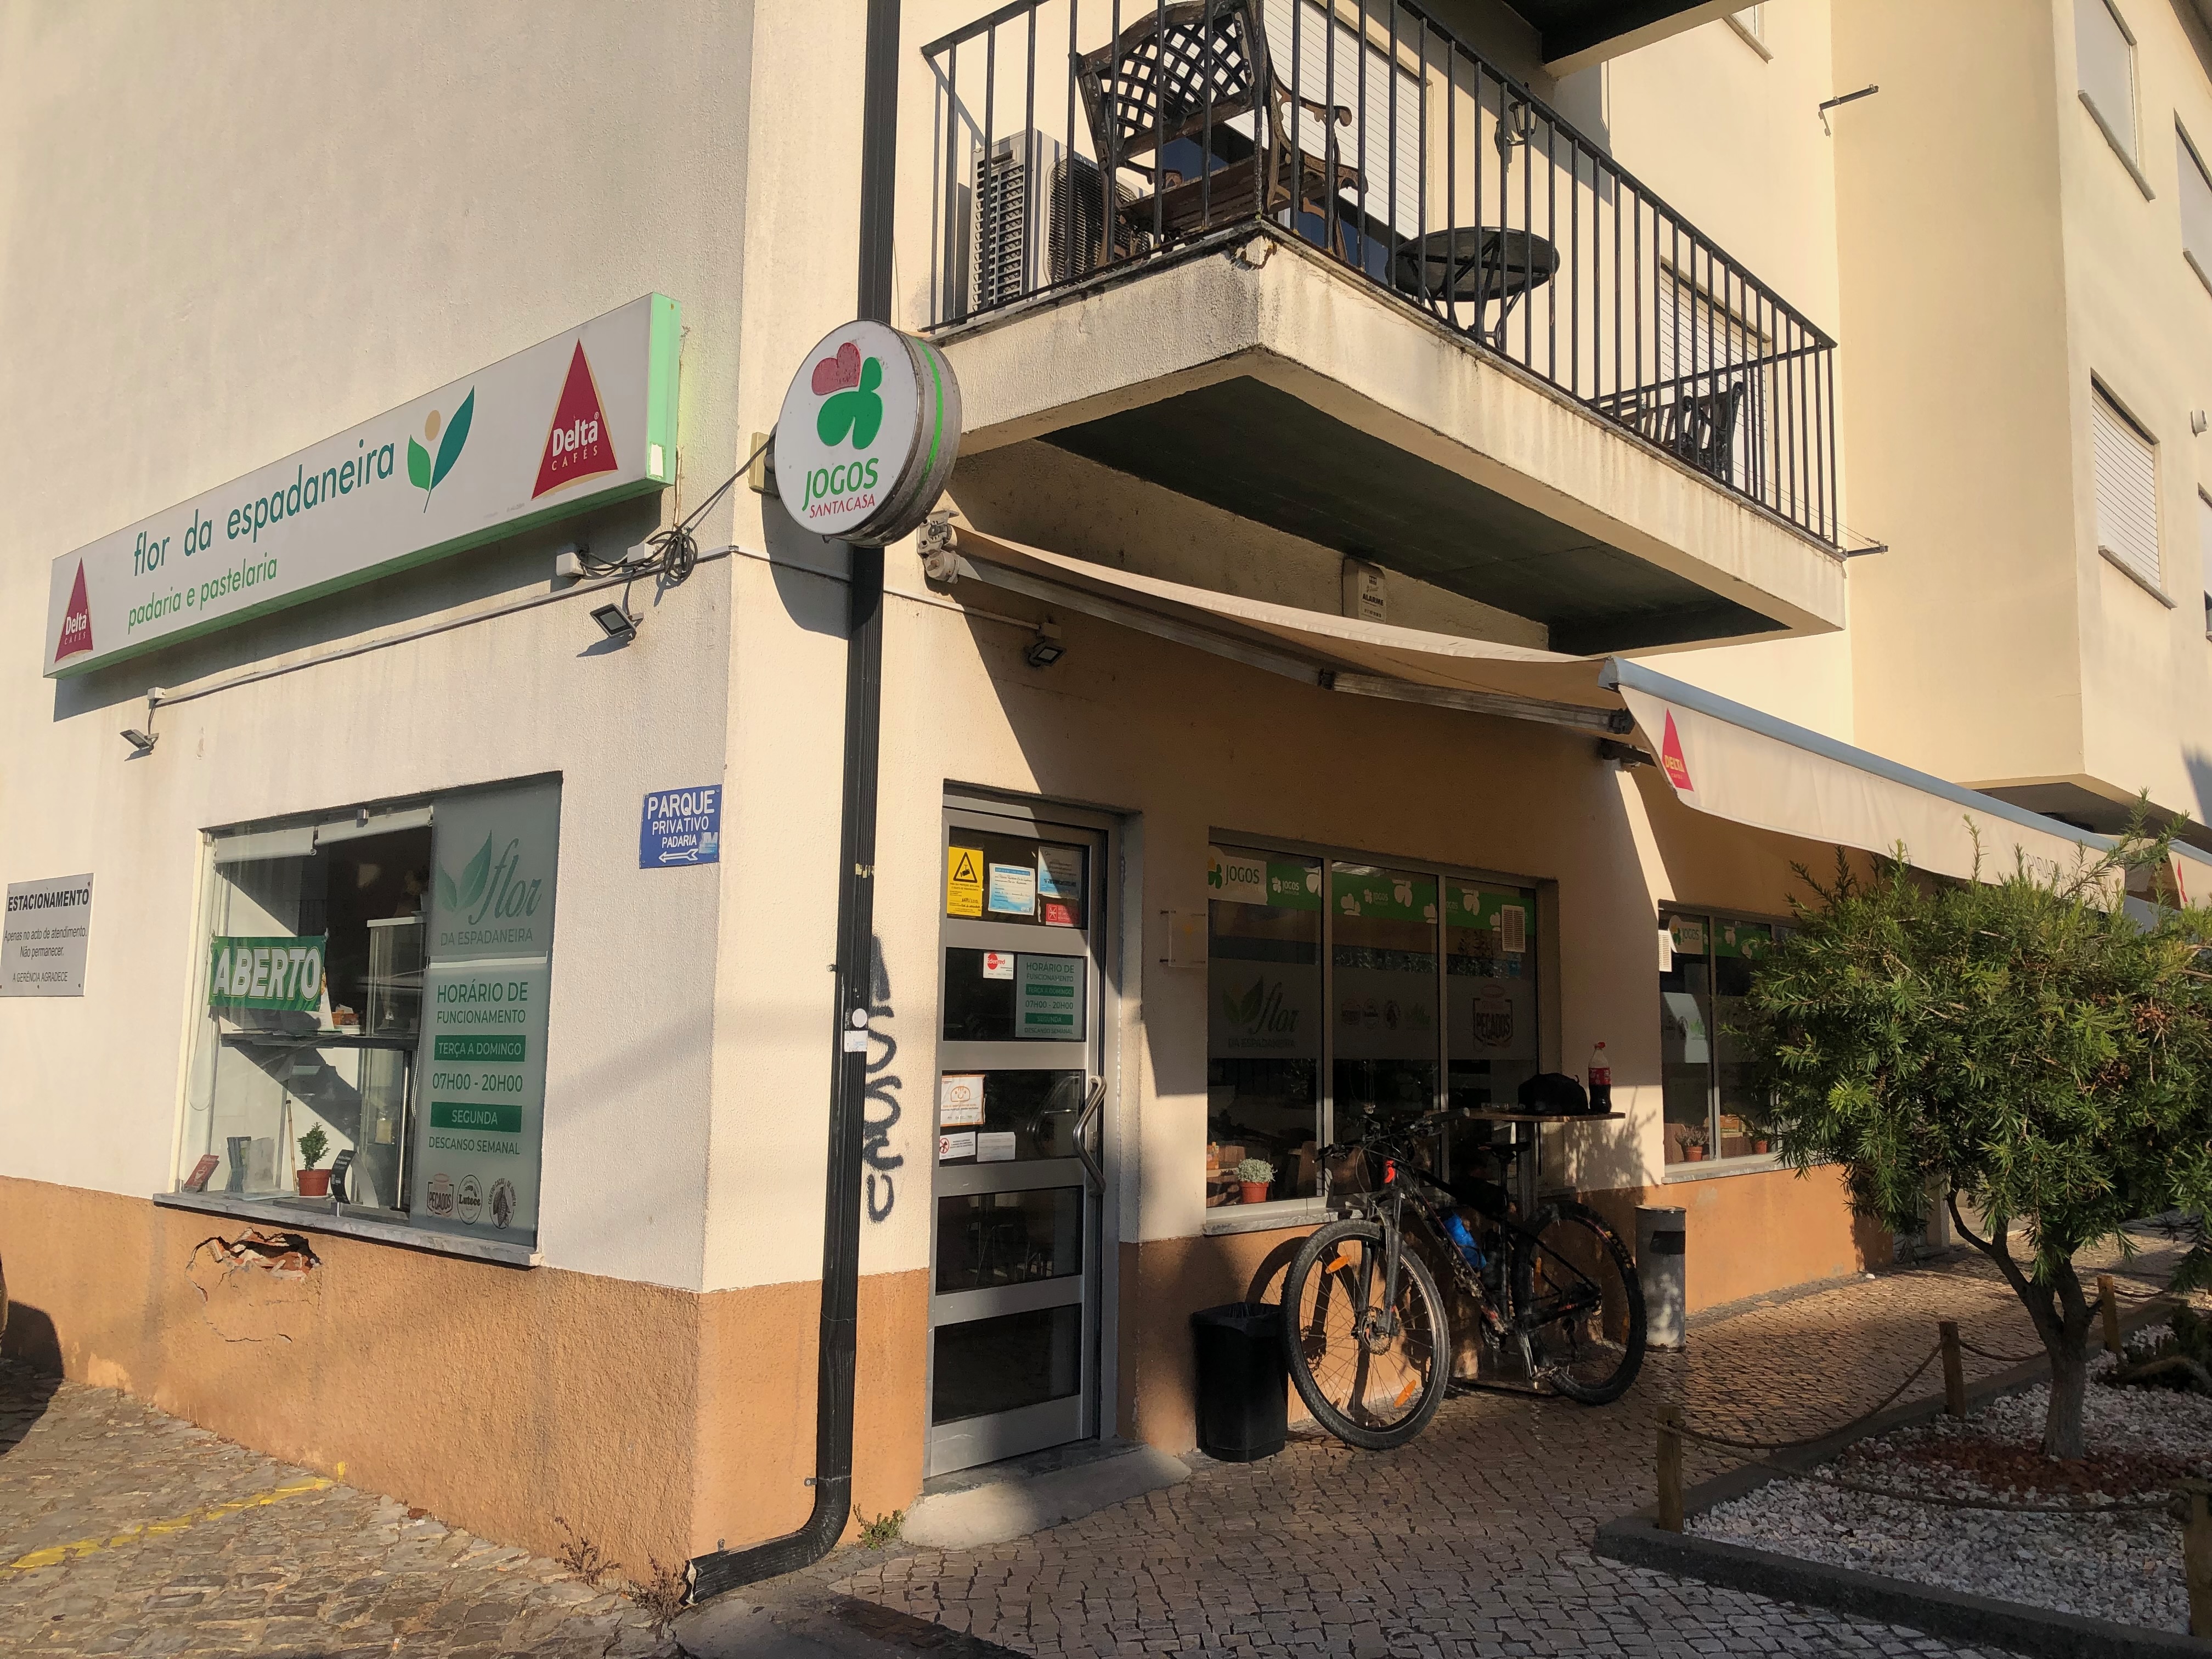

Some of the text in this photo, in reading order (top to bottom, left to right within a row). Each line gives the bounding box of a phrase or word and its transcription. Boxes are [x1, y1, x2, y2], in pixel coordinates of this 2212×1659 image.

[552, 419, 598, 457] Delta
[551, 445, 597, 471] CAFÉS
[802, 458, 879, 511] JOGOS
[134, 439, 394, 576] flor da espadaneira
[128, 552, 277, 635] padaria e pastelaria
[1362, 593, 1384, 606] ALARME
[1664, 754, 1685, 772] DELTA
[648, 790, 715, 820] PARQUE
[652, 816, 709, 835] PRIVATIVO
[662, 834, 697, 848] PADARIA
[469, 838, 541, 925] flor
[1225, 865, 1260, 885] JOGOS
[1282, 881, 1299, 891] JOGOS
[8, 889, 89, 911] ESTACIONAMENTO
[4, 926, 87, 943] Apenas no acto de atendimento.
[441, 928, 533, 946] DA ESPADANEIRA
[20, 946, 64, 960] Não permanecer.
[13, 970, 68, 982] A GERÊNCIA AGRADECE
[212, 946, 321, 1001] ABERTO
[1026, 961, 1074, 973] HORÁRIO DE
[1026, 973, 1074, 982] FUNCIONAMENTO
[437, 979, 528, 1003] HORÁRIO DE
[1025, 1000, 1047, 1008] 07H00
[1053, 1001, 1073, 1009] 20H00
[1247, 982, 1299, 1035] flor
[437, 1009, 526, 1024] FUNCIONAMENTO
[1476, 1013, 1510, 1040] PECADOS
[438, 1042, 521, 1057] TERÇA A DOMINGO
[432, 1073, 471, 1090] 07H00
[482, 1074, 523, 1092] 20H00
[452, 1110, 498, 1125] SEGUNDA
[428, 1136, 520, 1155] DESCANSO SEMANAL
[429, 1192, 451, 1210] PECADOS
[459, 1194, 481, 1206] Lutece
